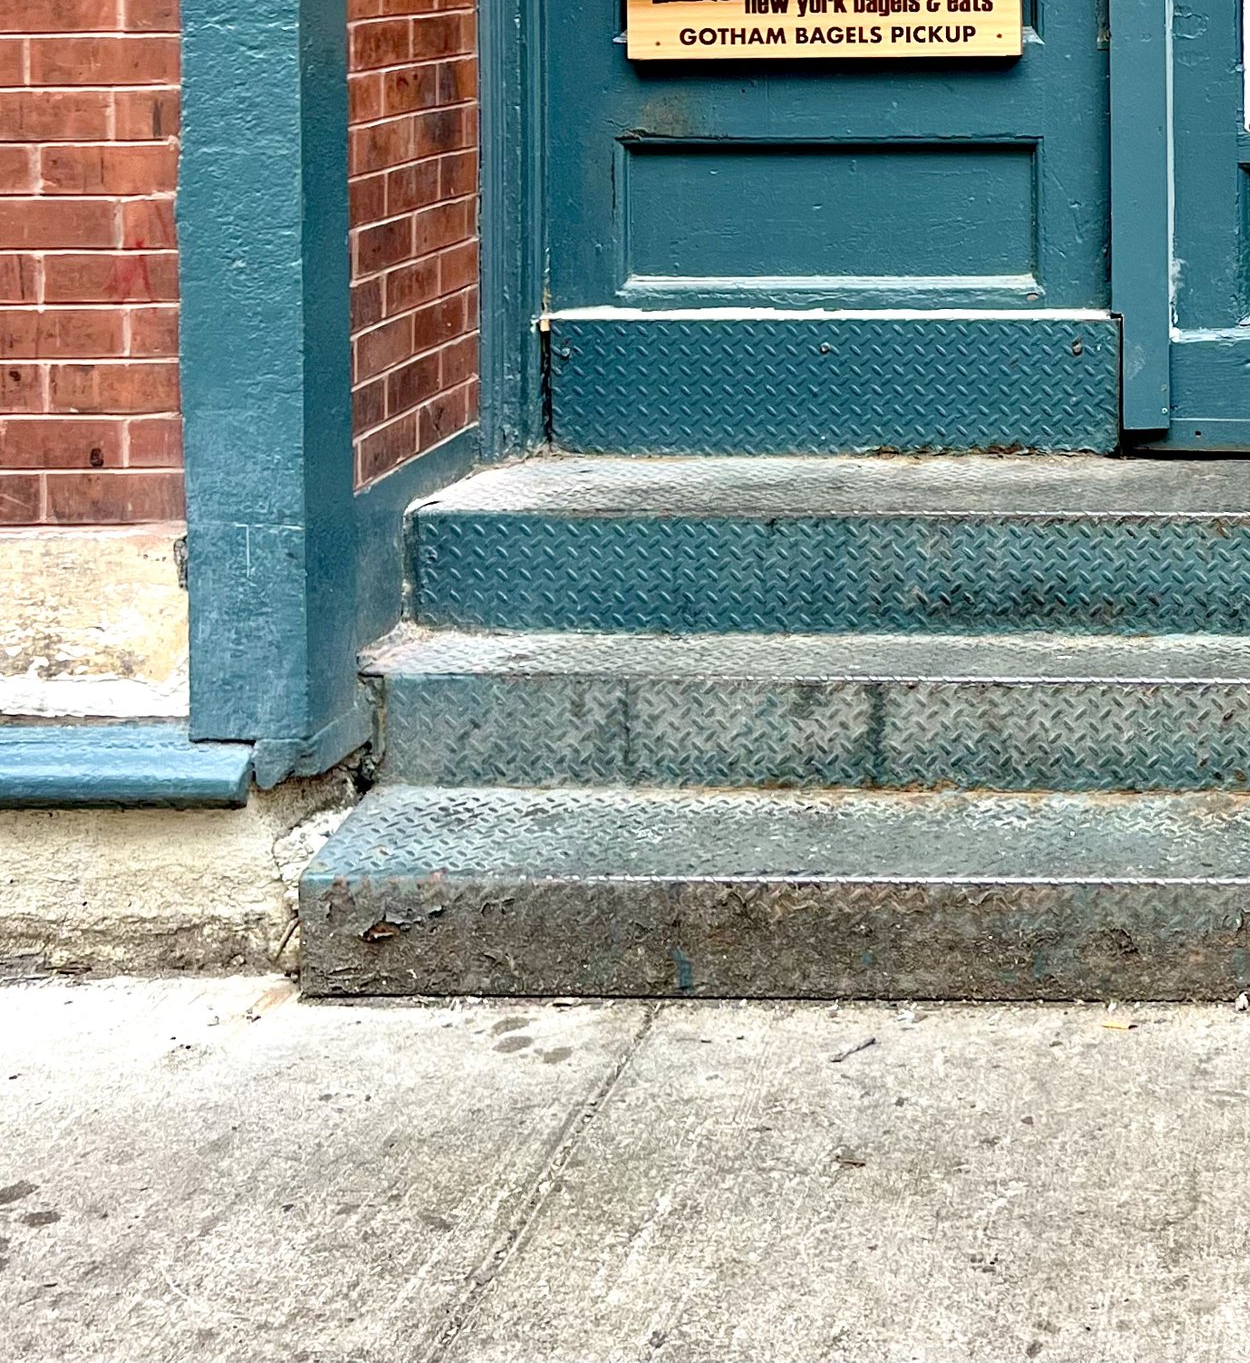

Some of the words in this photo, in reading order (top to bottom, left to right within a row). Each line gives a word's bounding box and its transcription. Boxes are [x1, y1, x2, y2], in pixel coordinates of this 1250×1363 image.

[680, 27, 786, 46] GOTHAM
[795, 26, 882, 44] BAGELS
[891, 25, 977, 44] PICKUP
